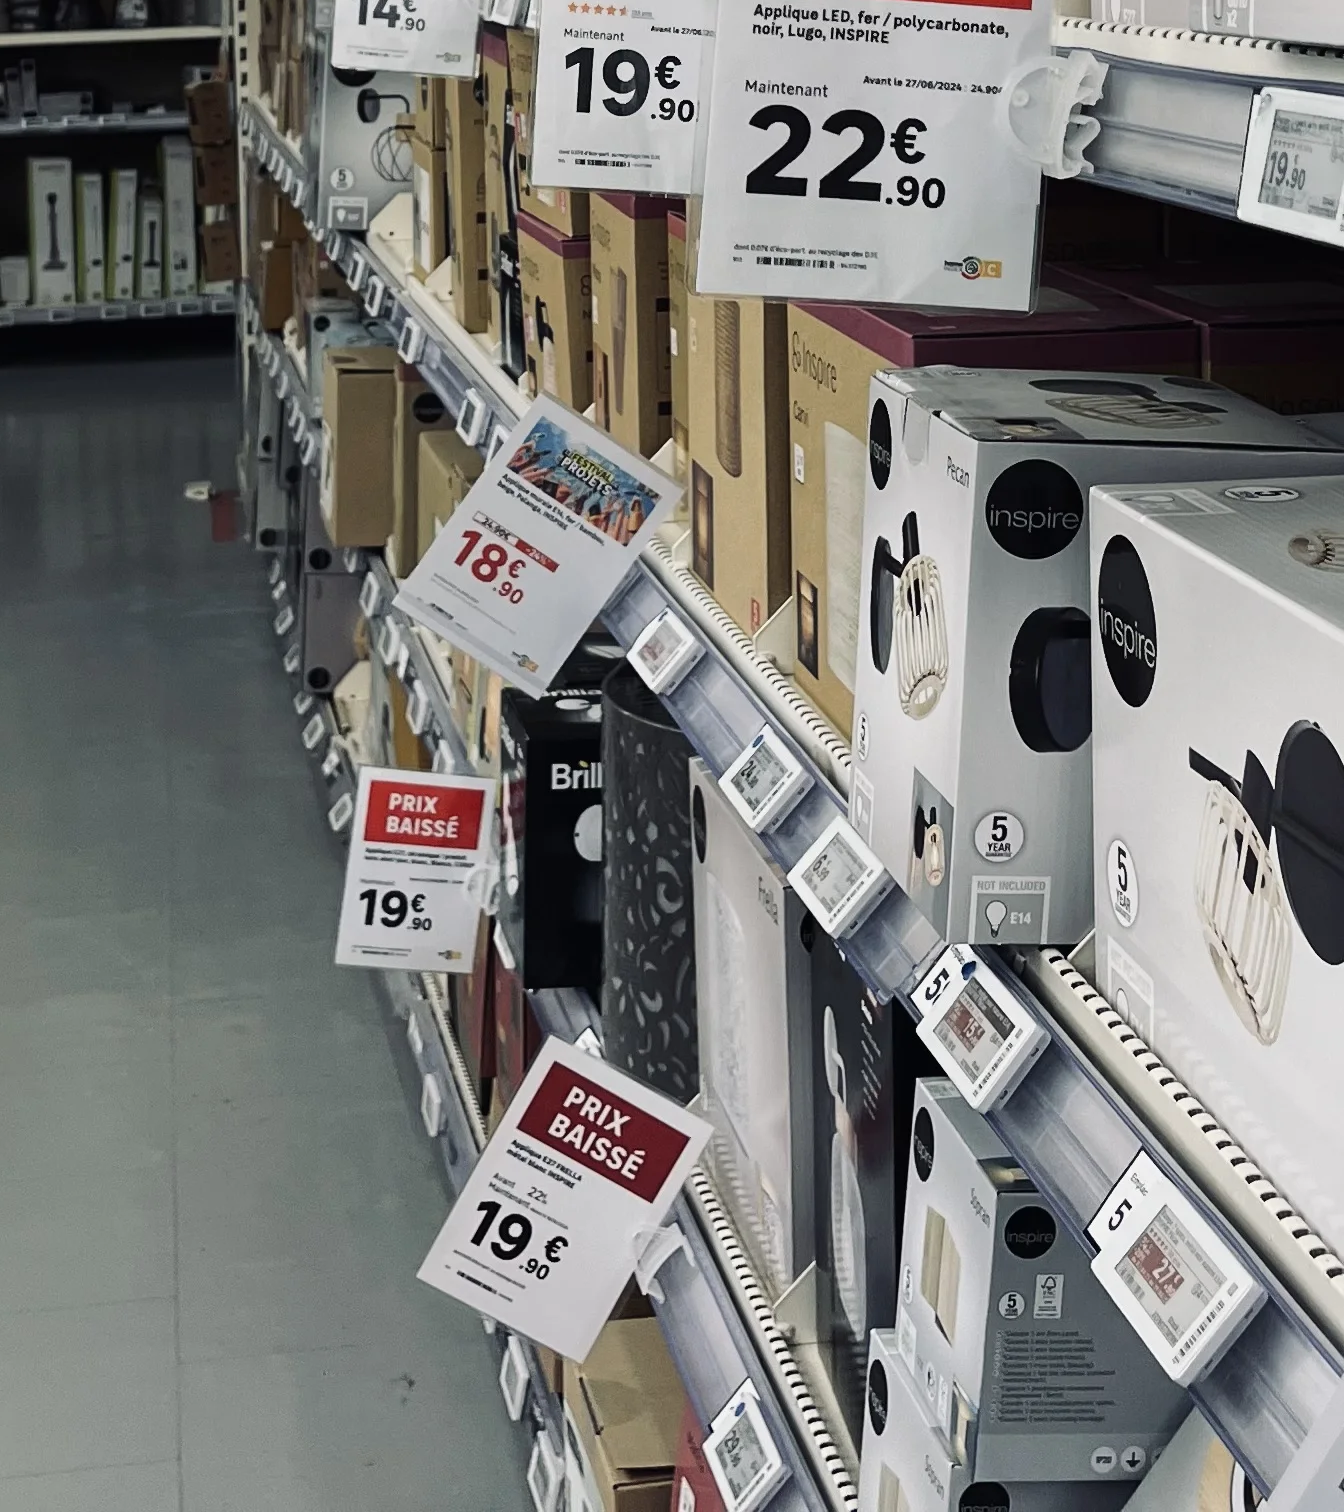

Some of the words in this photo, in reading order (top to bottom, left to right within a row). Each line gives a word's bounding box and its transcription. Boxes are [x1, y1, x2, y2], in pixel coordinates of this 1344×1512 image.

[650, 25, 672, 33] Avant
[753, 3, 819, 22] Applique
[822, 8, 855, 25] LED,
[857, 10, 881, 26] fer
[893, 15, 1010, 38] polycarbonate,
[563, 28, 625, 42] Maintenant
[752, 22, 785, 38] noir,
[788, 25, 827, 41] Lugo,
[830, 27, 890, 44] INSPIRE
[745, 79, 829, 98] Maintenant
[862, 75, 892, 87] Avant
[893, 77, 903, 87] le
[337, 169, 346, 182] 5
[802, 340, 838, 393] Inspire
[560, 456, 613, 496] PROJETS
[946, 455, 970, 489] Pecan
[502, 474, 530, 495] Applique
[989, 504, 1080, 533] inspire
[1099, 597, 1156, 669] inspire
[551, 760, 603, 790] Brill
[388, 792, 438, 814] PRIX
[385, 815, 459, 839] BAISSÉ
[990, 816, 1008, 842] 5
[987, 842, 1011, 853] YEAR
[1117, 846, 1128, 892] 5
[976, 880, 995, 891] NOT
[998, 880, 1046, 891] INCLUDED
[1010, 911, 1032, 925] E14
[924, 968, 950, 1001] 5
[563, 1085, 631, 1137] PRIX
[547, 1112, 646, 1181] BAISSÉ
[1108, 1198, 1133, 1231] 5
[1006, 1231, 1054, 1246] inspire
[1007, 1294, 1017, 1309] 5
